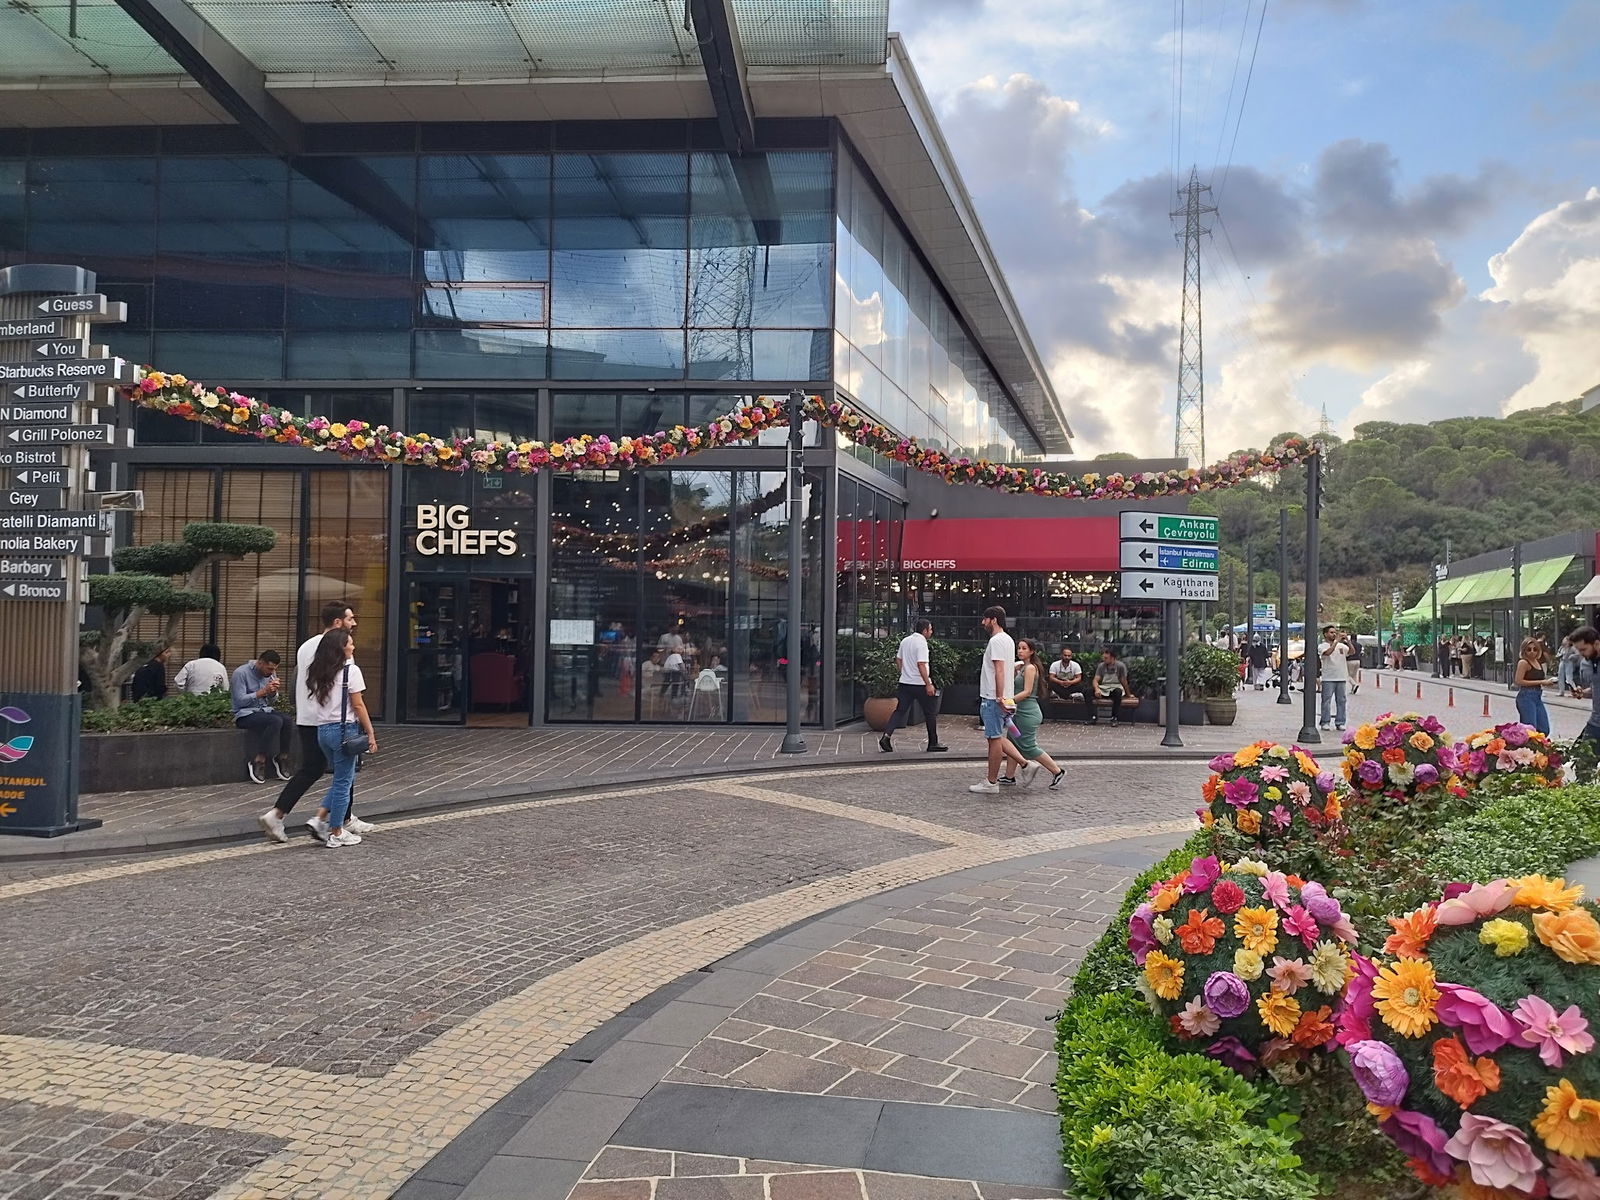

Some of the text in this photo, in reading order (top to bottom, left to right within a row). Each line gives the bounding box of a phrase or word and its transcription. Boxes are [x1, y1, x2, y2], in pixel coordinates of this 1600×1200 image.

[53, 299, 93, 311] Guess
[52, 343, 76, 355] You
[0, 363, 106, 379] Starbucks Reserve
[28, 385, 81, 398] Butterfly
[0, 406, 67, 420] N Diamond
[22, 428, 103, 441] Grill Polonez
[16, 451, 56, 464] Bistrot
[33, 470, 60, 483] Pelit
[9, 492, 39, 507] Grey
[37, 514, 96, 528] Diamanti
[416, 504, 470, 530] BIG
[1179, 519, 1215, 530] Ankara
[1163, 527, 1215, 540] Çevreyolu
[0, 537, 78, 552] nolia Bakery
[415, 529, 518, 556] CHEFS
[1, 559, 52, 577] Barbary
[902, 559, 957, 569] BIGCHEFS
[1182, 558, 1215, 569] Edirne
[1163, 577, 1214, 588] Kağıthane
[19, 584, 61, 597] Bronco
[1180, 588, 1215, 598] Hasdal
